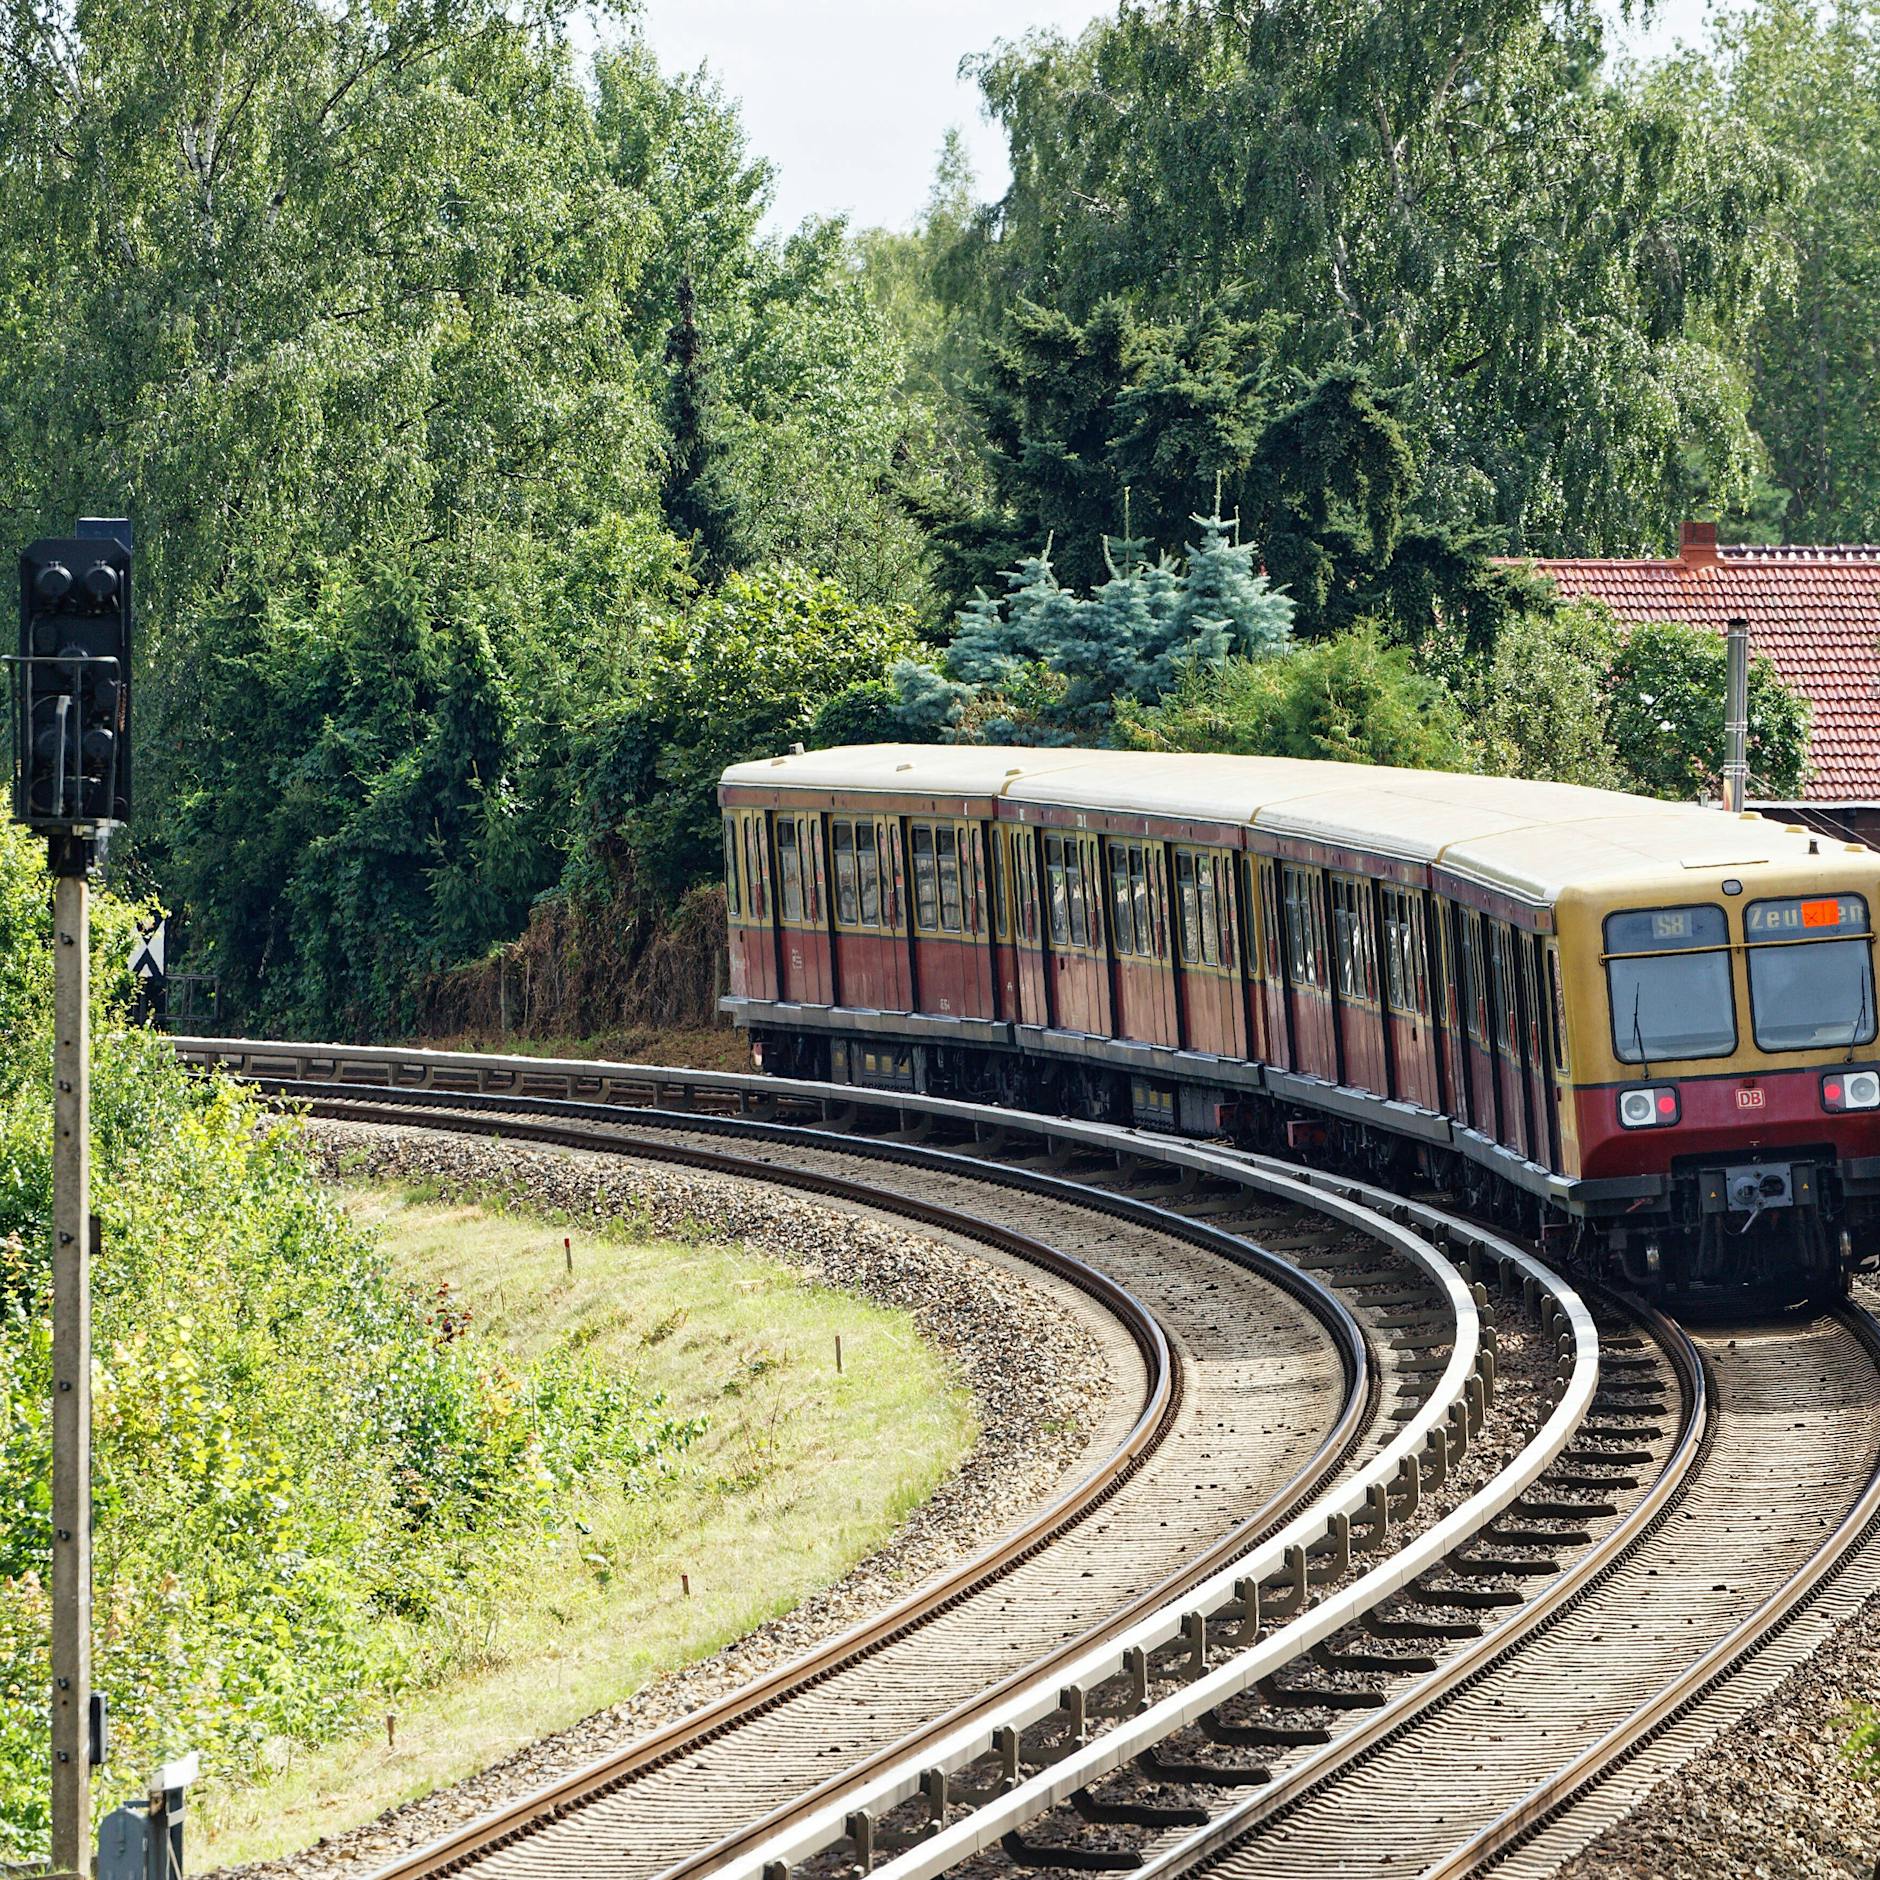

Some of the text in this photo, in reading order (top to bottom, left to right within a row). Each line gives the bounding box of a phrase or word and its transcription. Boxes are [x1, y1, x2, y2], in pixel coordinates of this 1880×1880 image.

[1656, 913, 1685, 937] S8
[1750, 904, 1864, 929] Zeuen
[1740, 1091, 1761, 1105] DB
